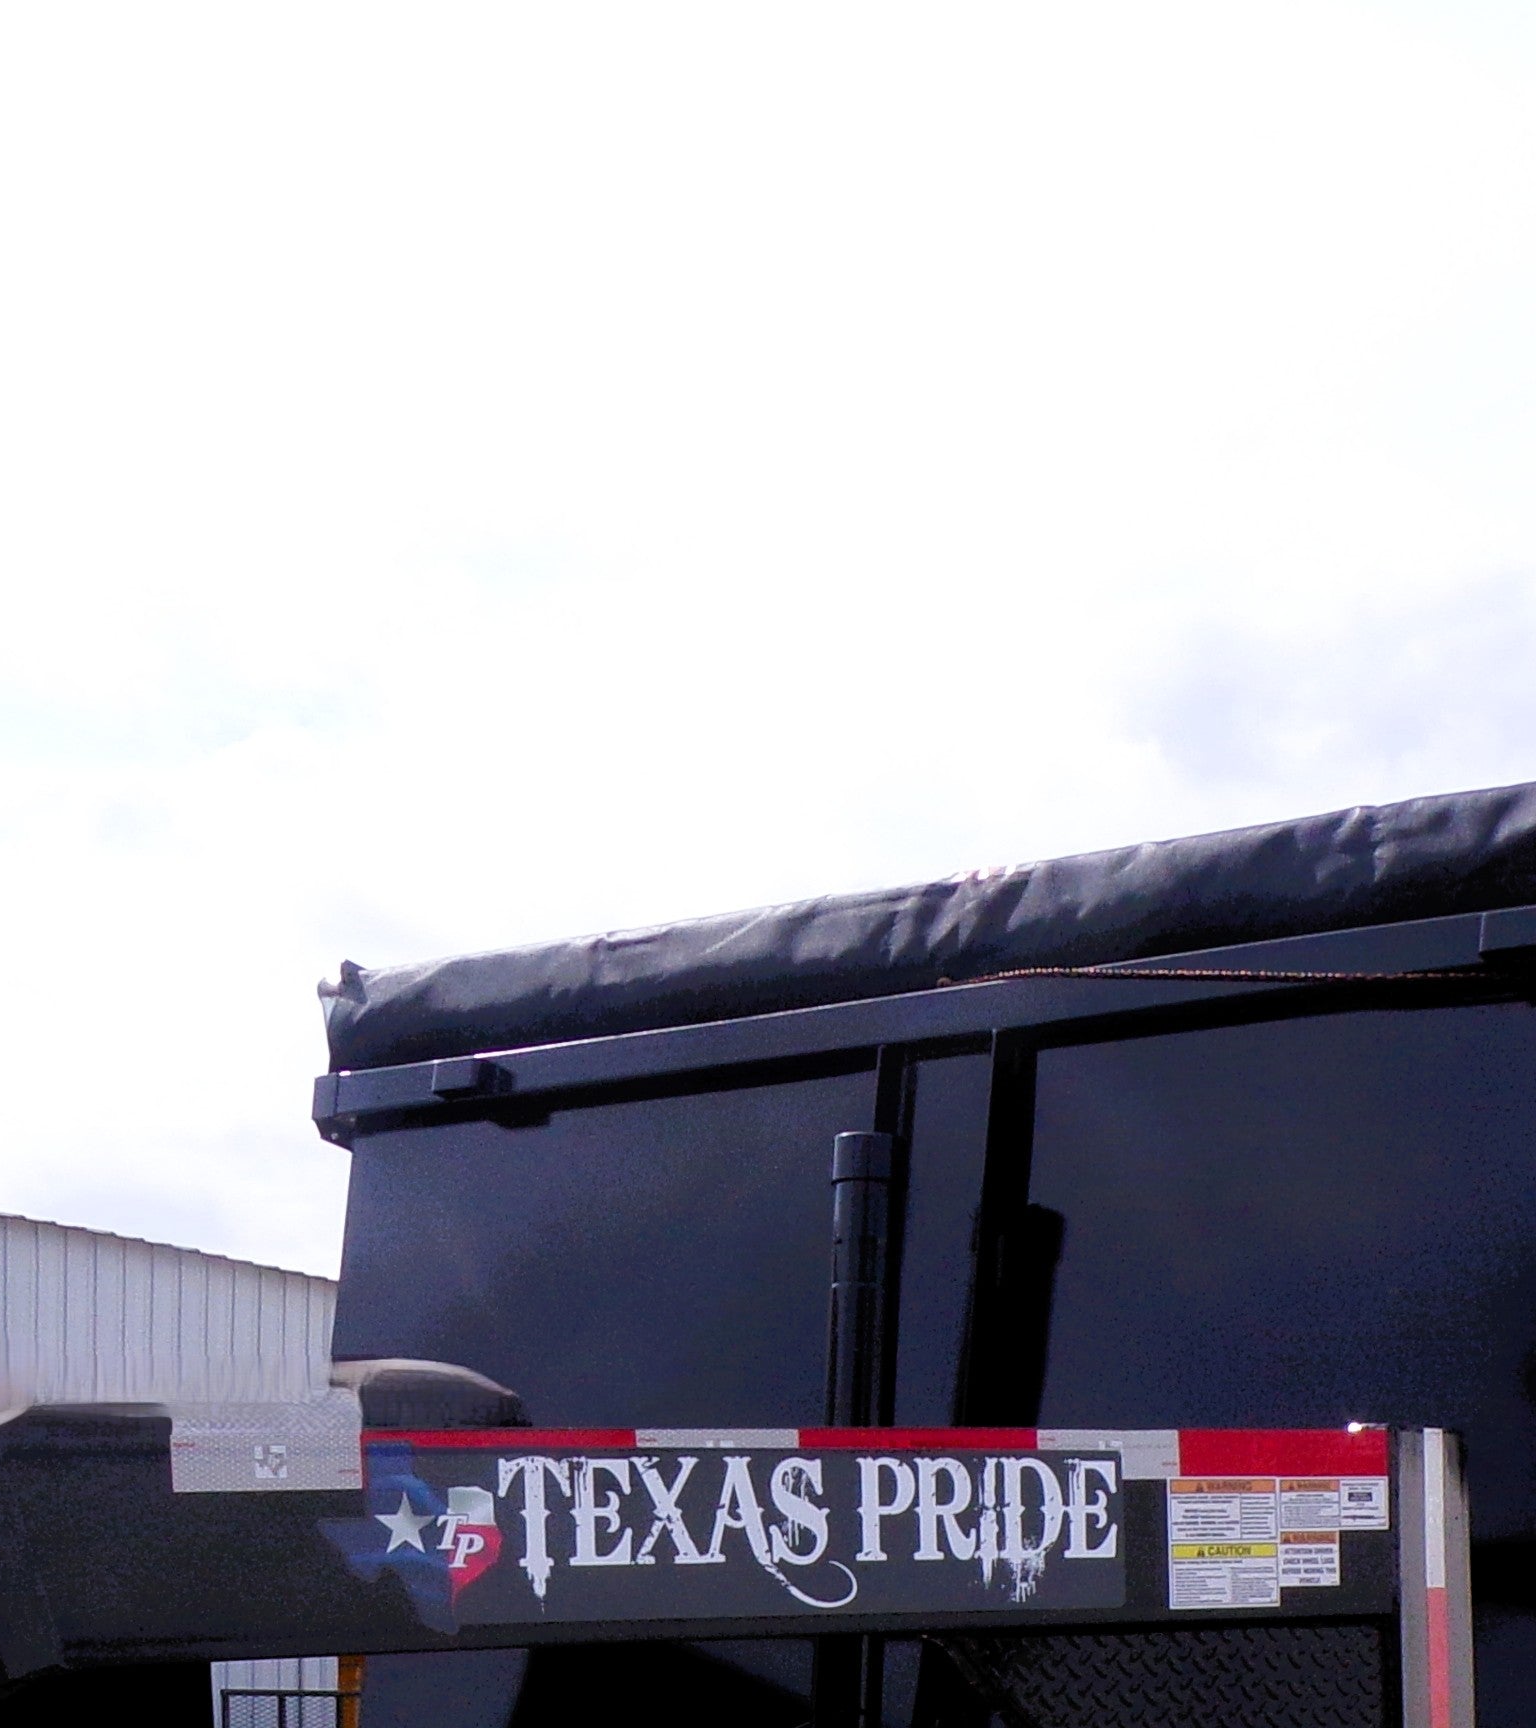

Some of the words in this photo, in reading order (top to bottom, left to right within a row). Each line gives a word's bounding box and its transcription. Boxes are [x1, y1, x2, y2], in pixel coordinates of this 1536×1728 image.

[497, 1456, 857, 1608] TEXAS
[856, 1456, 1118, 1602] PRIDE
[1207, 1545, 1252, 1556] CAUTION
